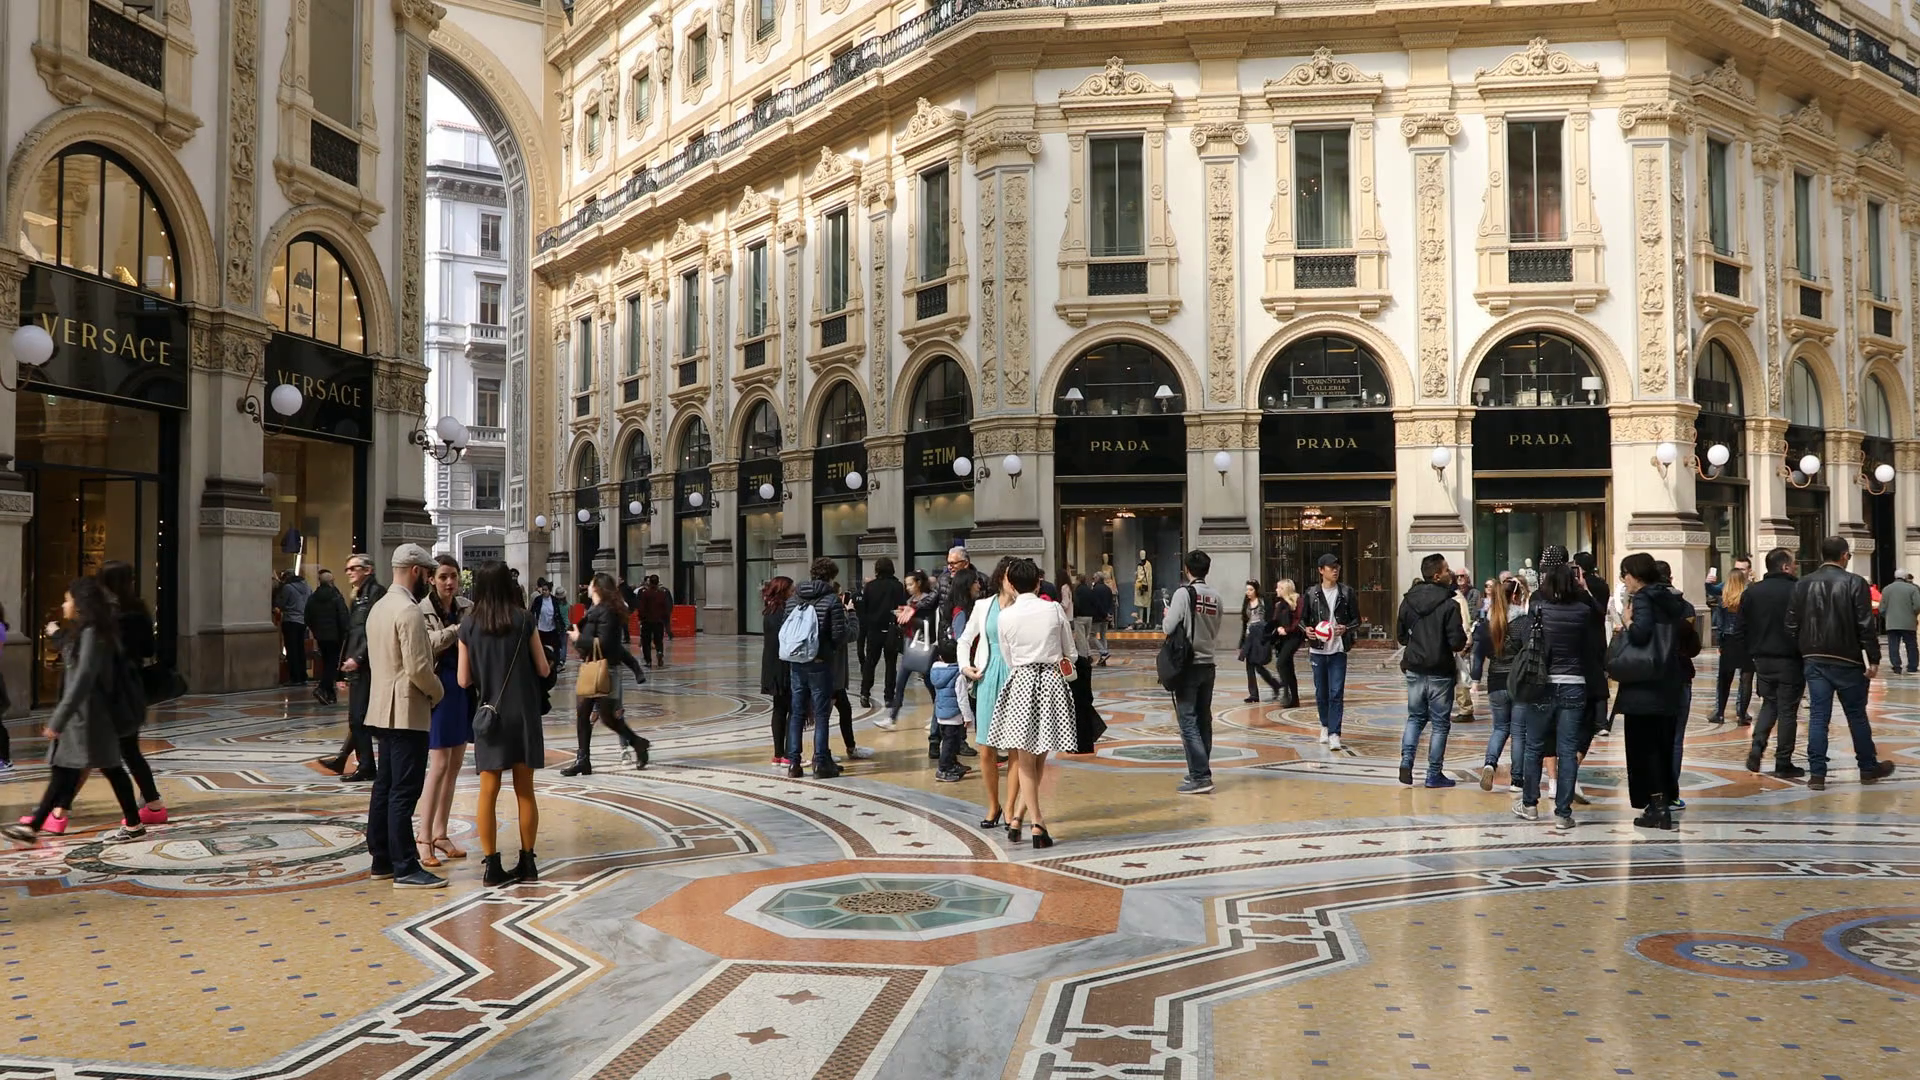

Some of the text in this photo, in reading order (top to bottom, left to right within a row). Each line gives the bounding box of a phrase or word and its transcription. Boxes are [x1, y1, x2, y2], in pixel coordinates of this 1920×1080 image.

[41, 312, 171, 366] VERSACE
[1090, 440, 1150, 451] PRADA
[1296, 438, 1358, 449] PRADA
[1509, 434, 1572, 445] PRADA
[935, 446, 956, 465] TIM
[837, 461, 855, 478] TIM
